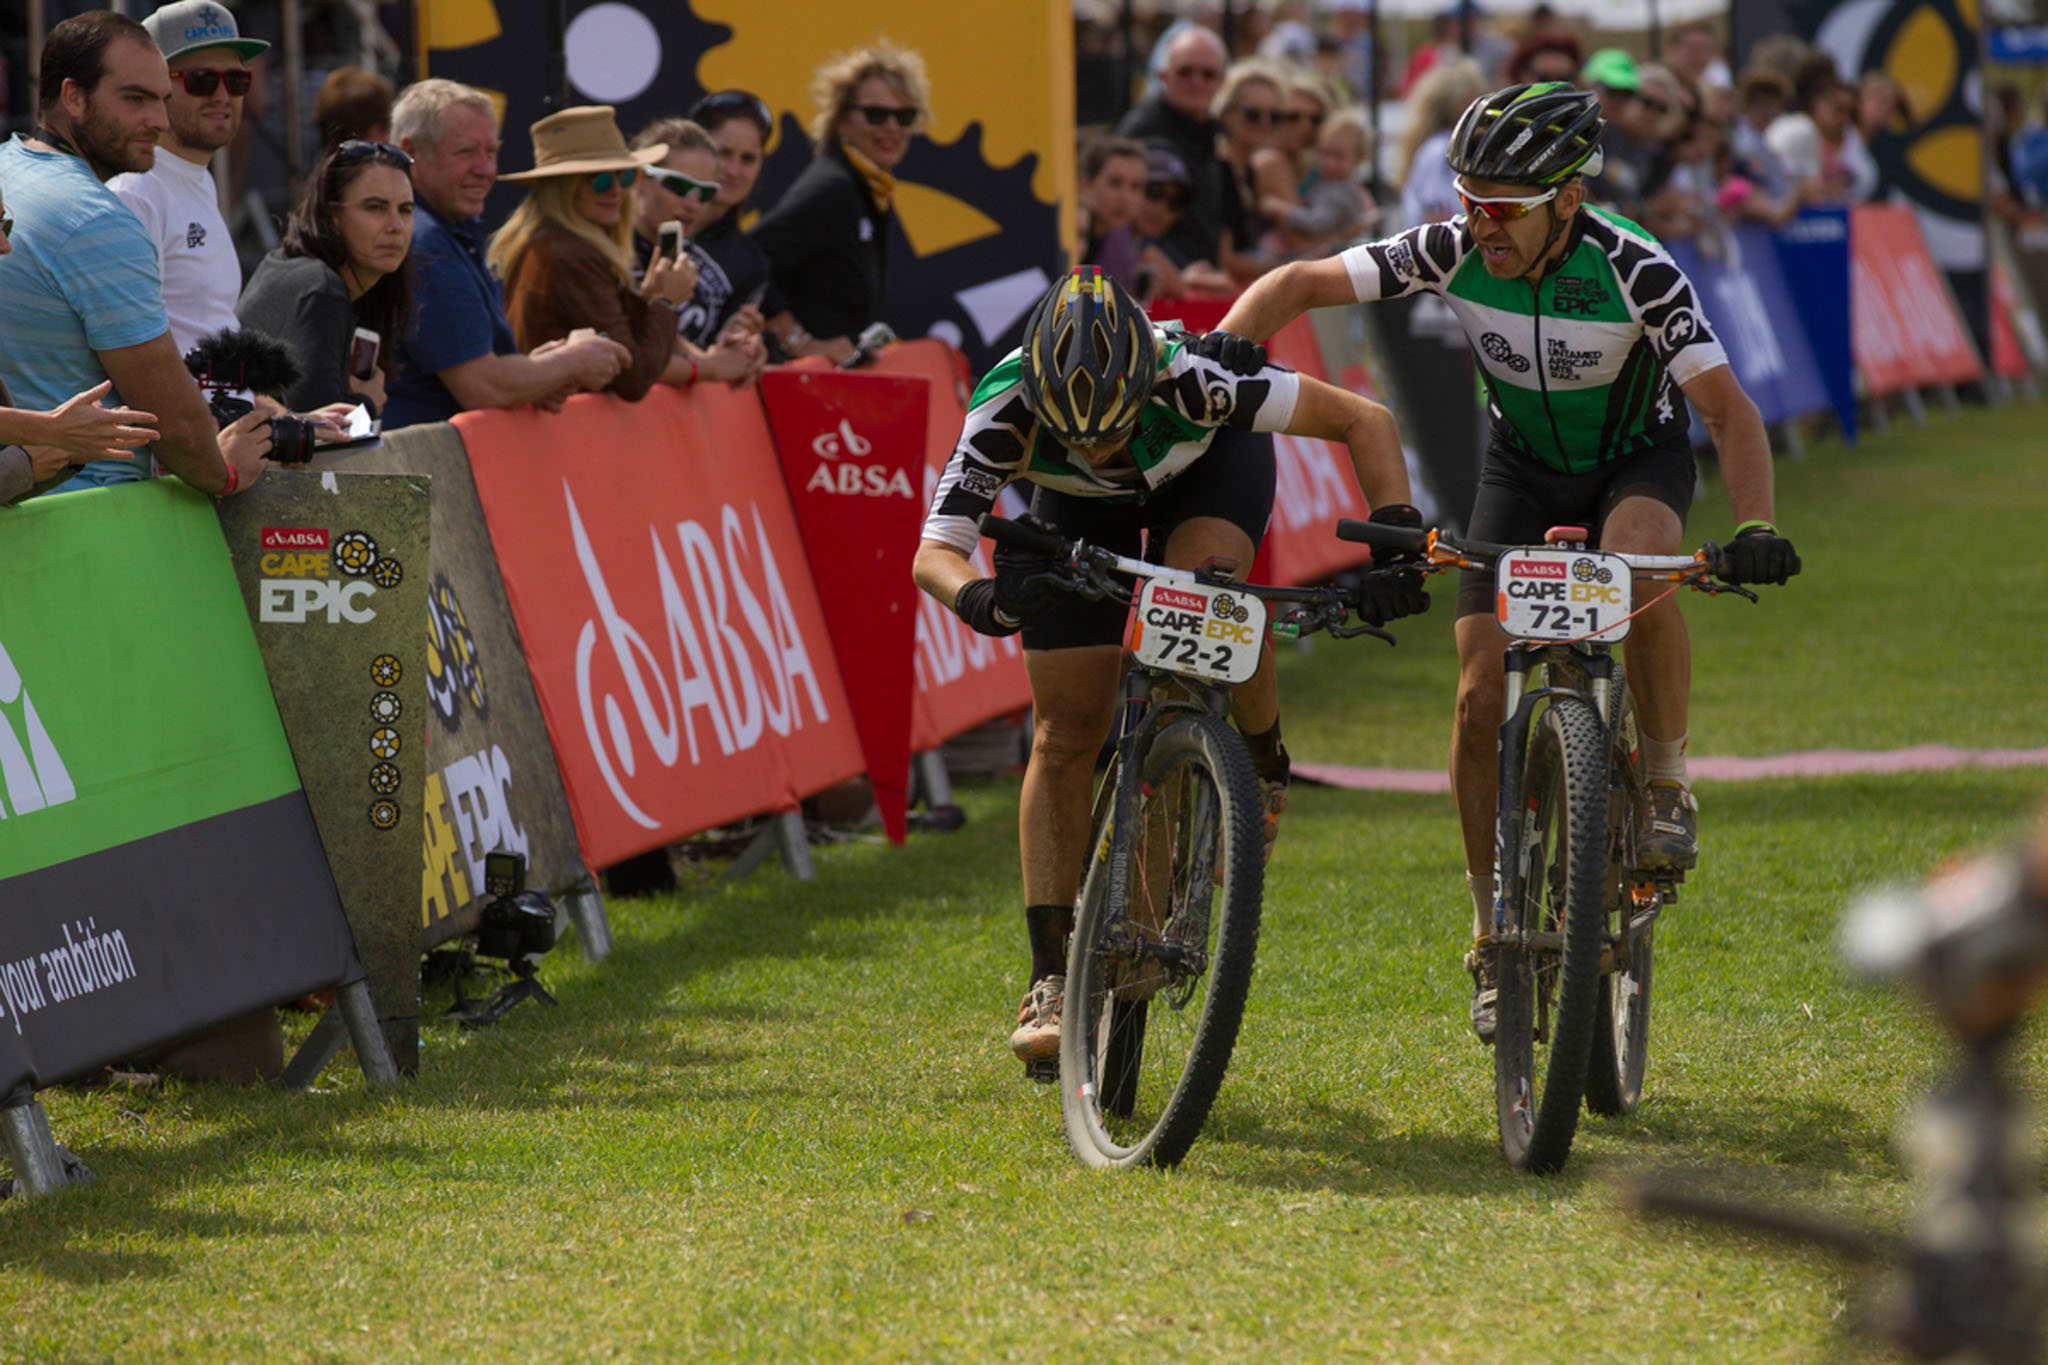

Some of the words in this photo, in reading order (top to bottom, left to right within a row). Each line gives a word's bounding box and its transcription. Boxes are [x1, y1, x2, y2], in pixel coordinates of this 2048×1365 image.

[1553, 295, 1601, 315] EPIC
[1547, 338, 1567, 349] THE
[1548, 347, 1603, 359] UNTAMED
[1549, 356, 1600, 368] AFRICAN
[806, 462, 915, 499] ABSA
[286, 532, 325, 546] ABSA
[260, 553, 330, 577] CAPE
[1531, 565, 1563, 576] ABSA
[259, 578, 378, 624] EPIC
[1173, 593, 1204, 610] ABSA
[1508, 580, 1567, 601] CAPE
[1571, 583, 1622, 605] EPIC
[1146, 607, 1204, 636] CAPE
[1205, 618, 1255, 645] EPIC
[1529, 604, 1598, 632] 72-1
[650, 499, 830, 767] ABSA
[1157, 633, 1233, 672] 72-2
[421, 770, 471, 930] APE
[0, 955, 47, 1036] your
[40, 915, 137, 1003] ambition
